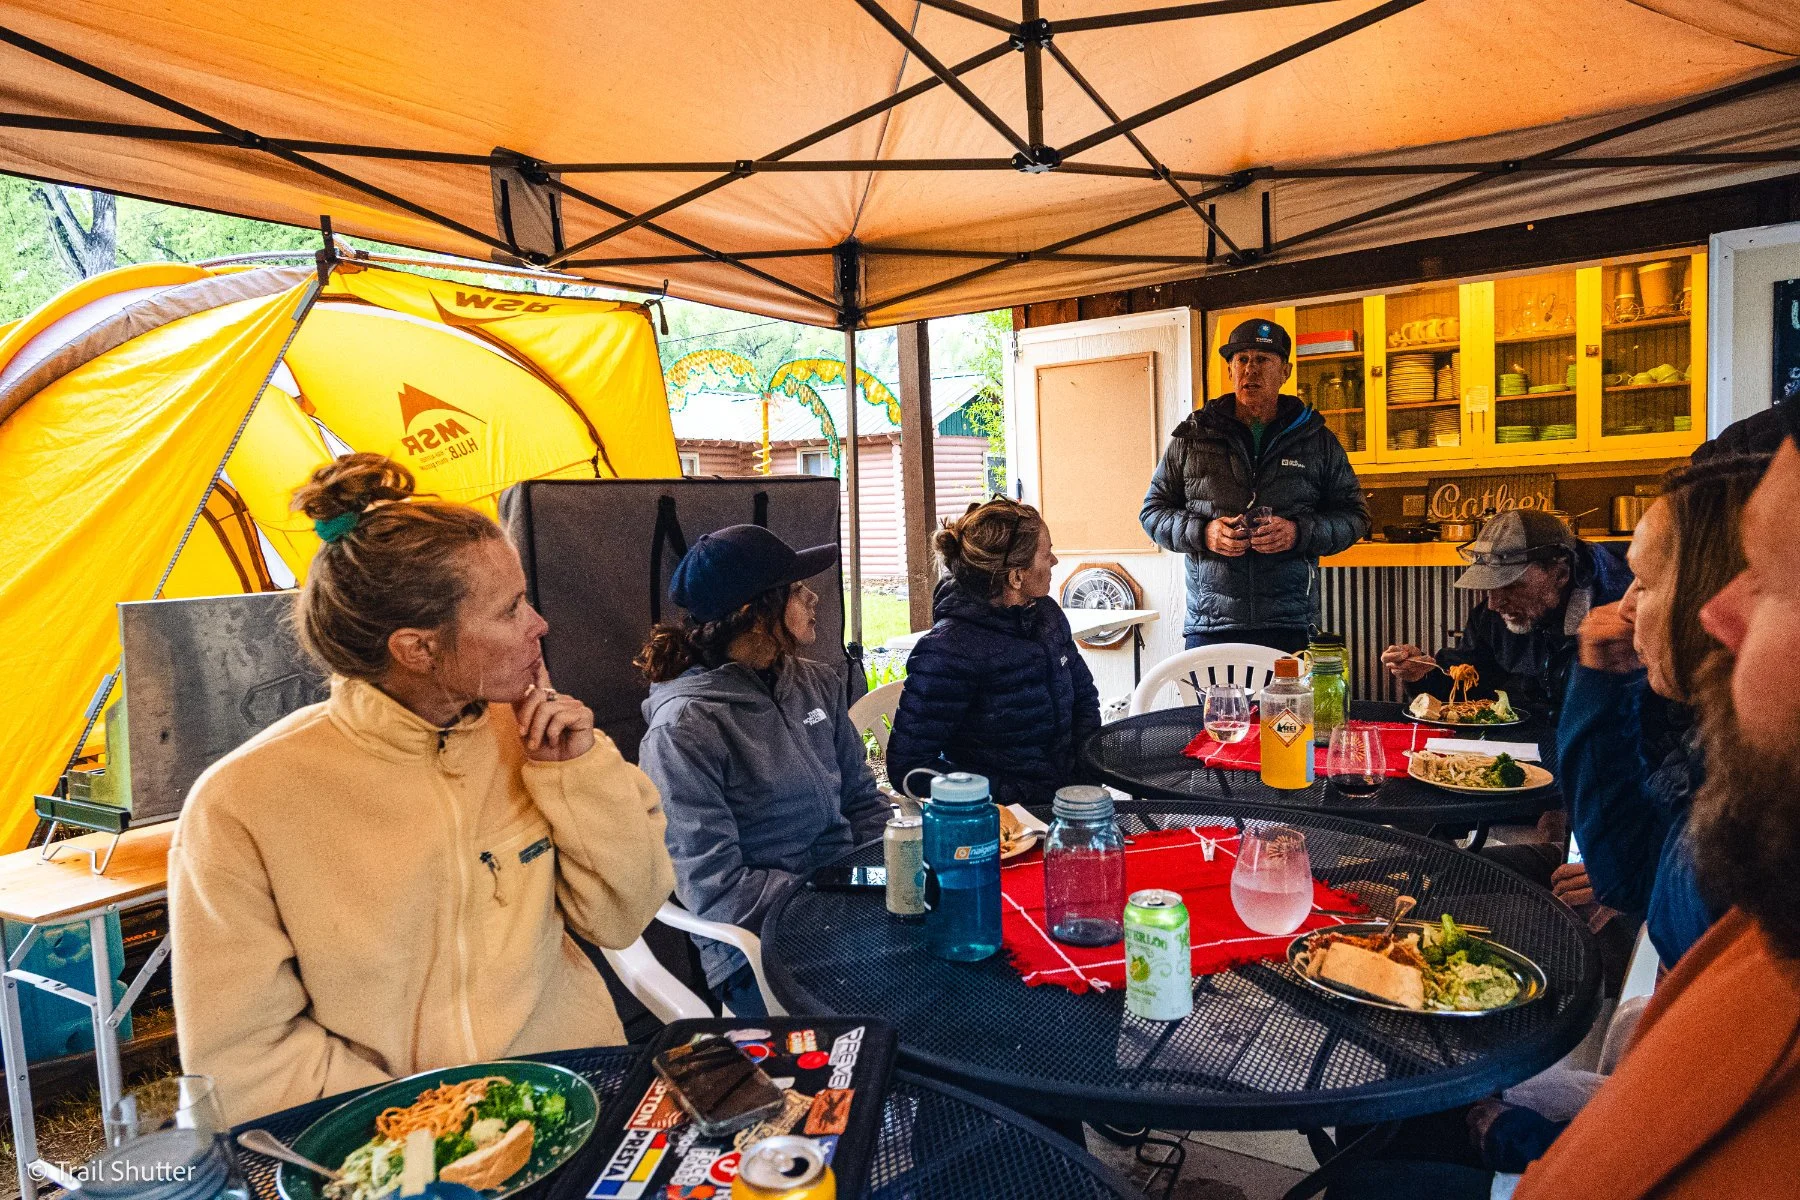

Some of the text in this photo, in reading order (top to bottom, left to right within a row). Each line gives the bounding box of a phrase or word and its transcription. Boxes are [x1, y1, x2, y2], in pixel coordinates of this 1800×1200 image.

[1431, 483, 1550, 520] Gather
[633, 1079, 668, 1127] PTON
[605, 1130, 649, 1178] PRESTA
